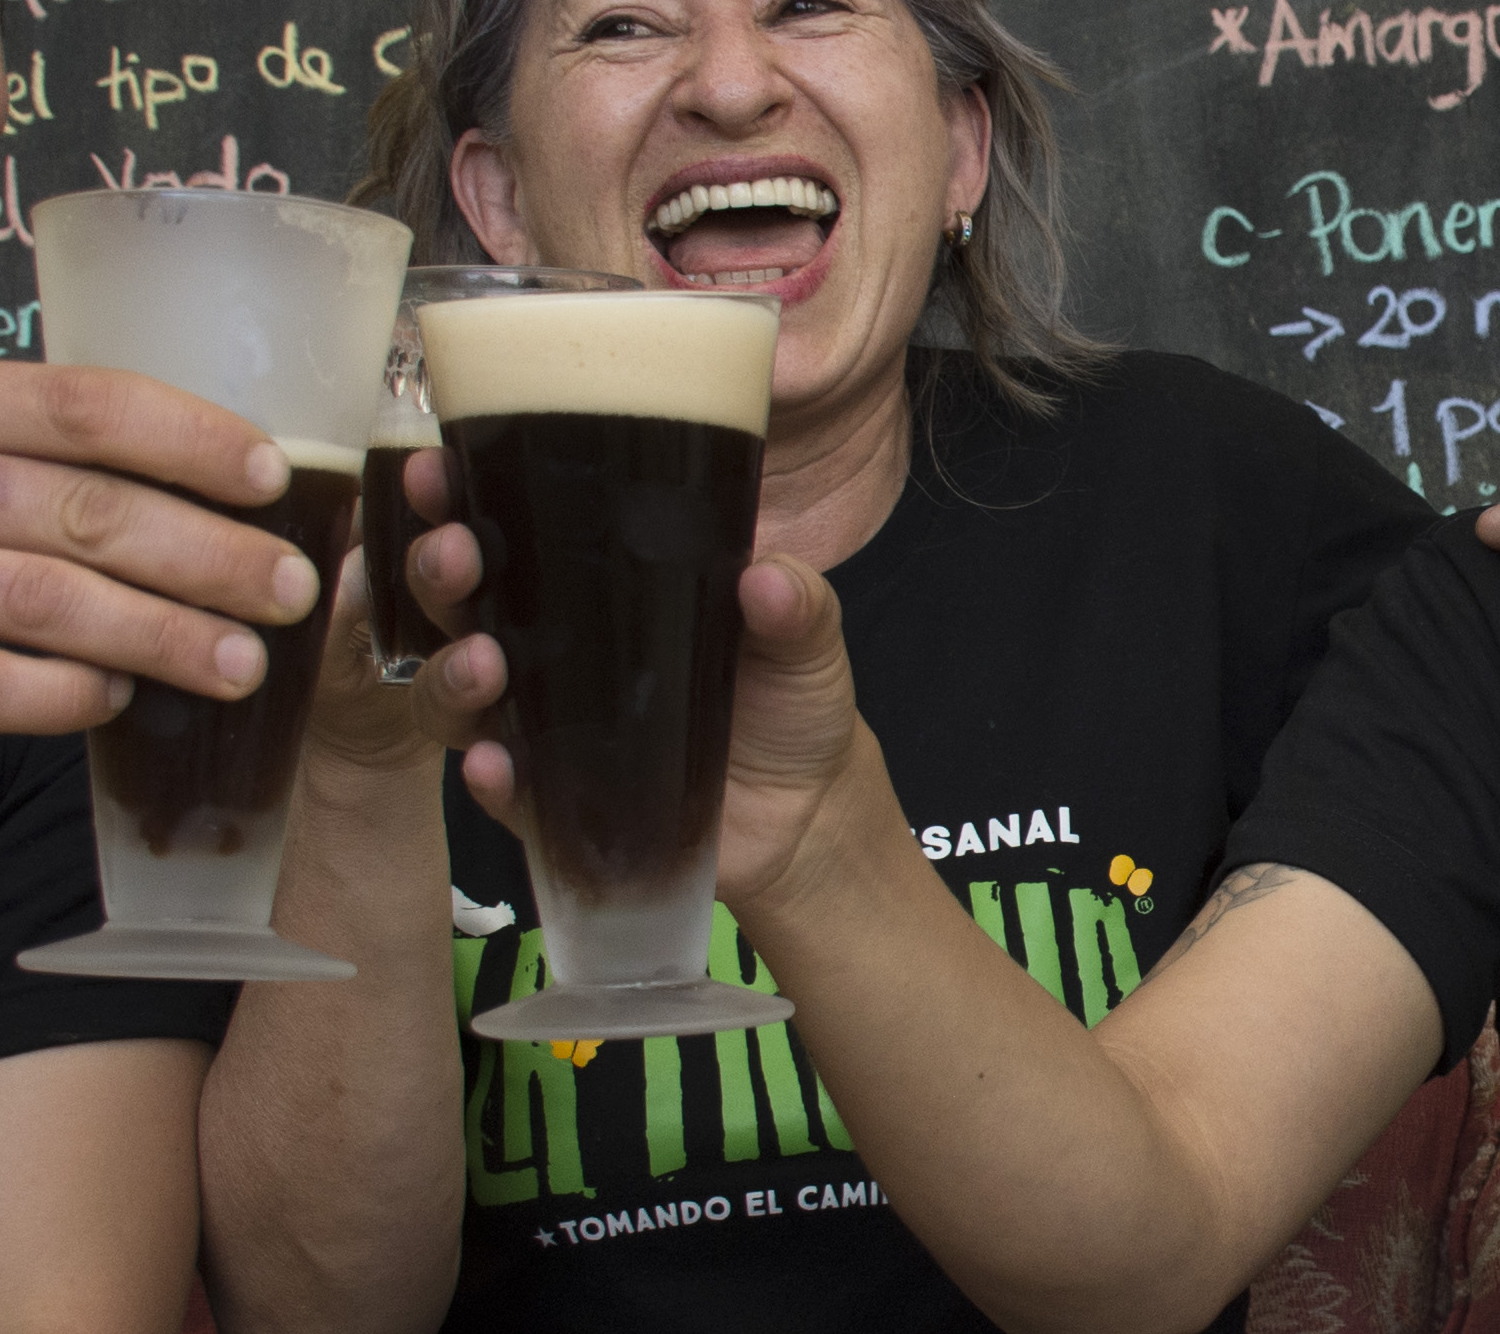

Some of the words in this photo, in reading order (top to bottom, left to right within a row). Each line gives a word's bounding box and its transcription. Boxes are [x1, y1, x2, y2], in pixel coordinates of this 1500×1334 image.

[96, 45, 219, 130] tipo
[257, 21, 347, 95] de
[1357, 284, 1446, 349] 20
[910, 806, 1080, 860] SANAL
[560, 1195, 731, 1245] TOMANDO
[746, 1189, 783, 1218] EL
[798, 1180, 888, 1213] CAMI
